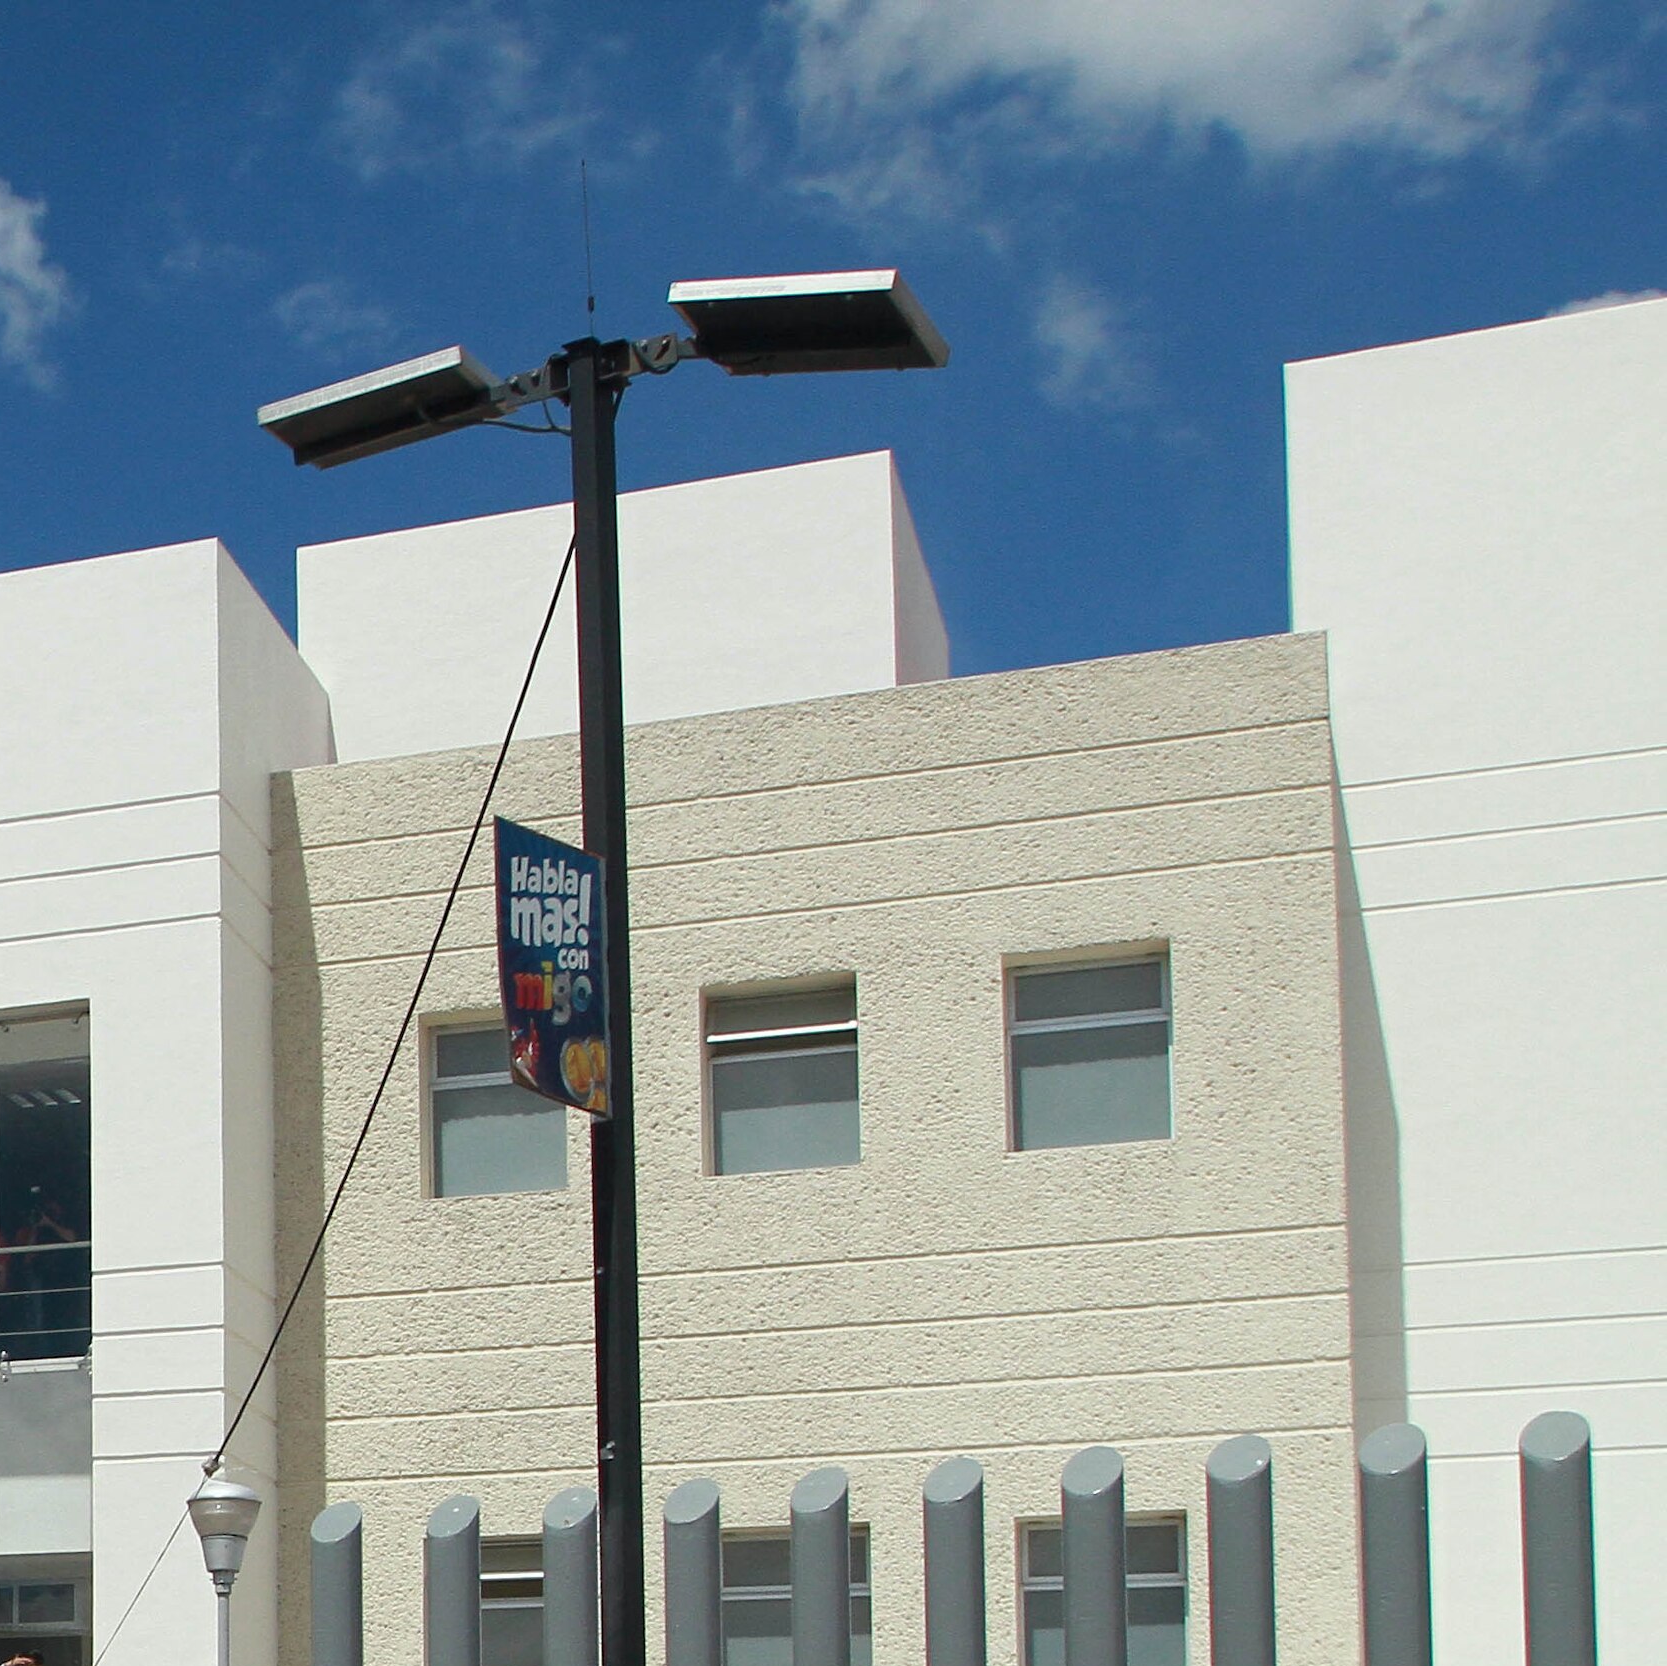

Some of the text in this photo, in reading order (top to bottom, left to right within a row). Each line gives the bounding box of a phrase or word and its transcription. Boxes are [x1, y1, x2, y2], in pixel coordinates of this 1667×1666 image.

[510, 856, 579, 896] Habla
[510, 873, 592, 948] mas!
[558, 948, 590, 970] con
[513, 961, 593, 1026] migo
